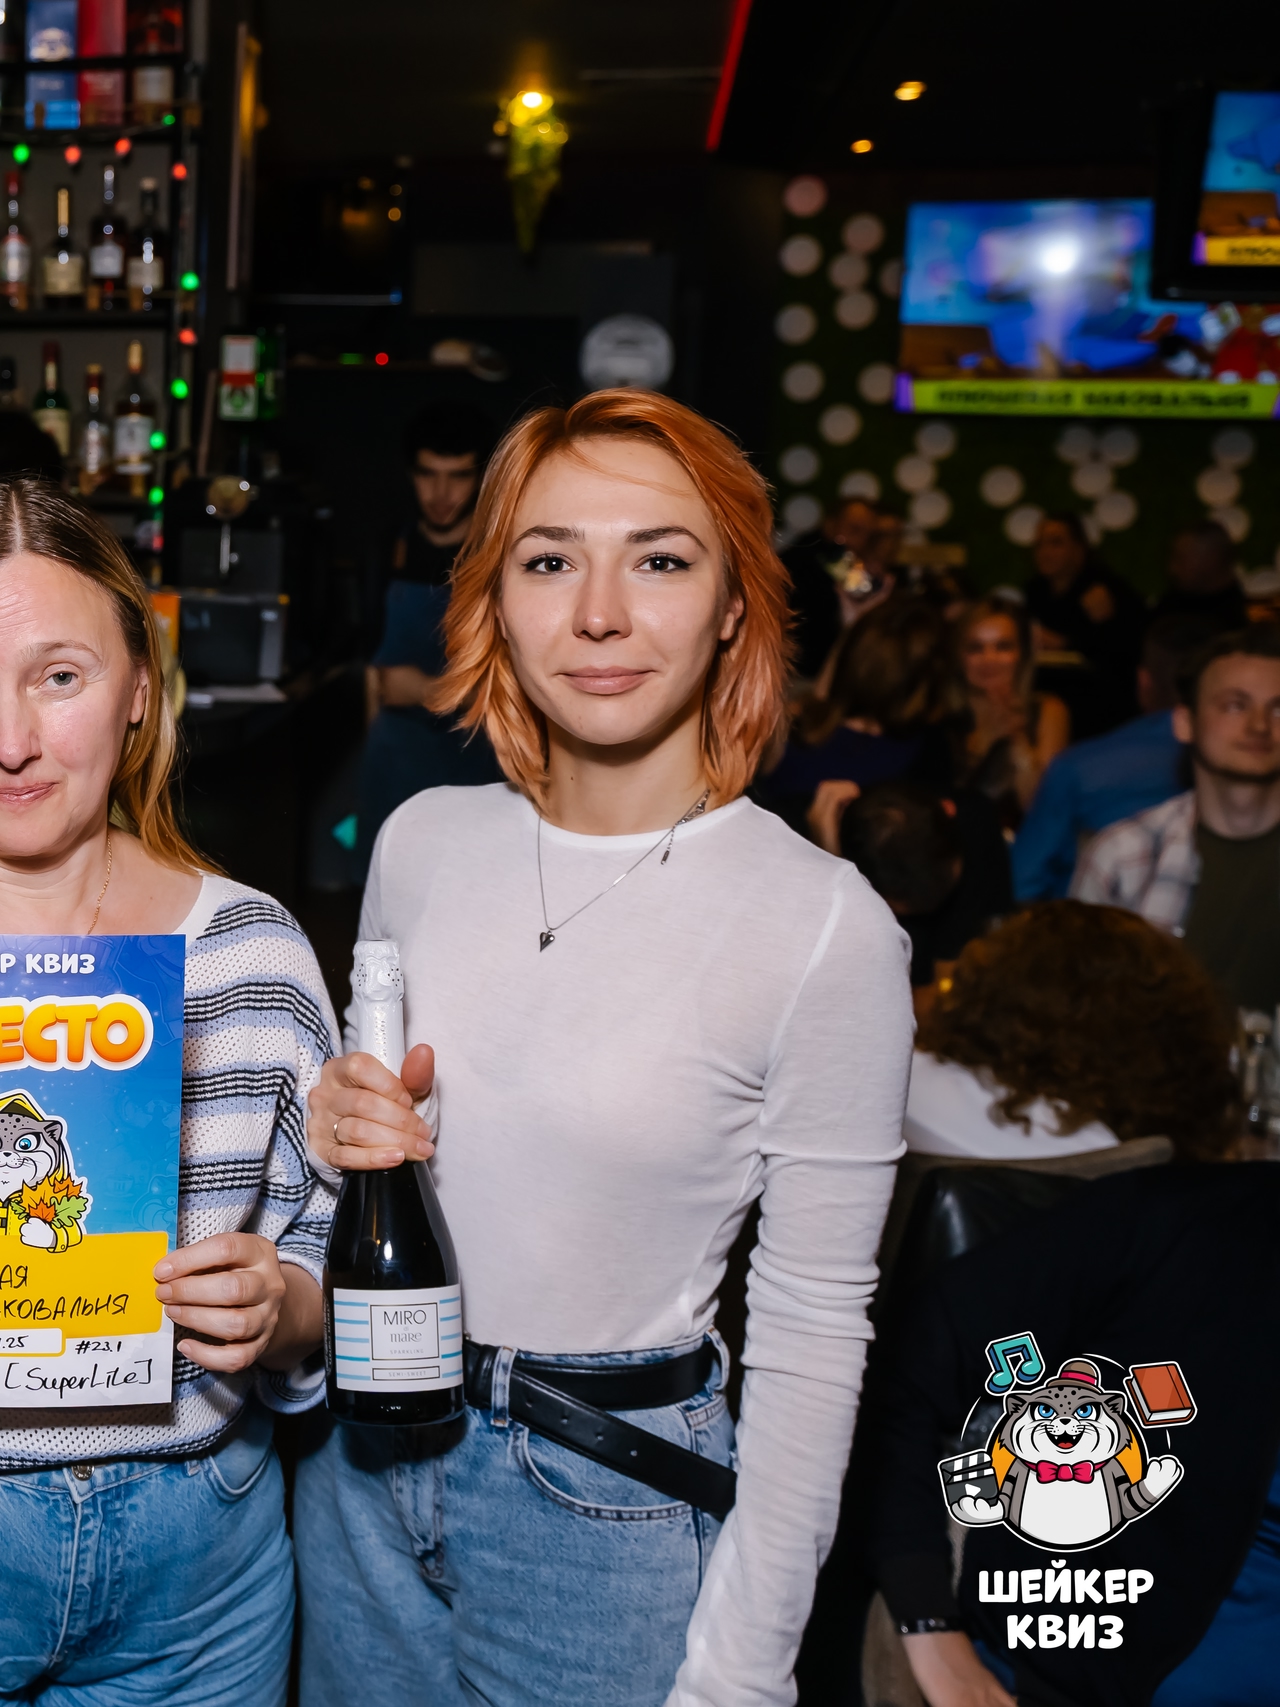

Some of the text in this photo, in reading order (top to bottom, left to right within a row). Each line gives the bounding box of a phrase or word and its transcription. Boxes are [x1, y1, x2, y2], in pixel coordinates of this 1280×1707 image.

[25, 953, 95, 974] КВИЗ
[383, 1309, 427, 1325] MIRO
[388, 1370, 427, 1378] SEMI-SWEET
